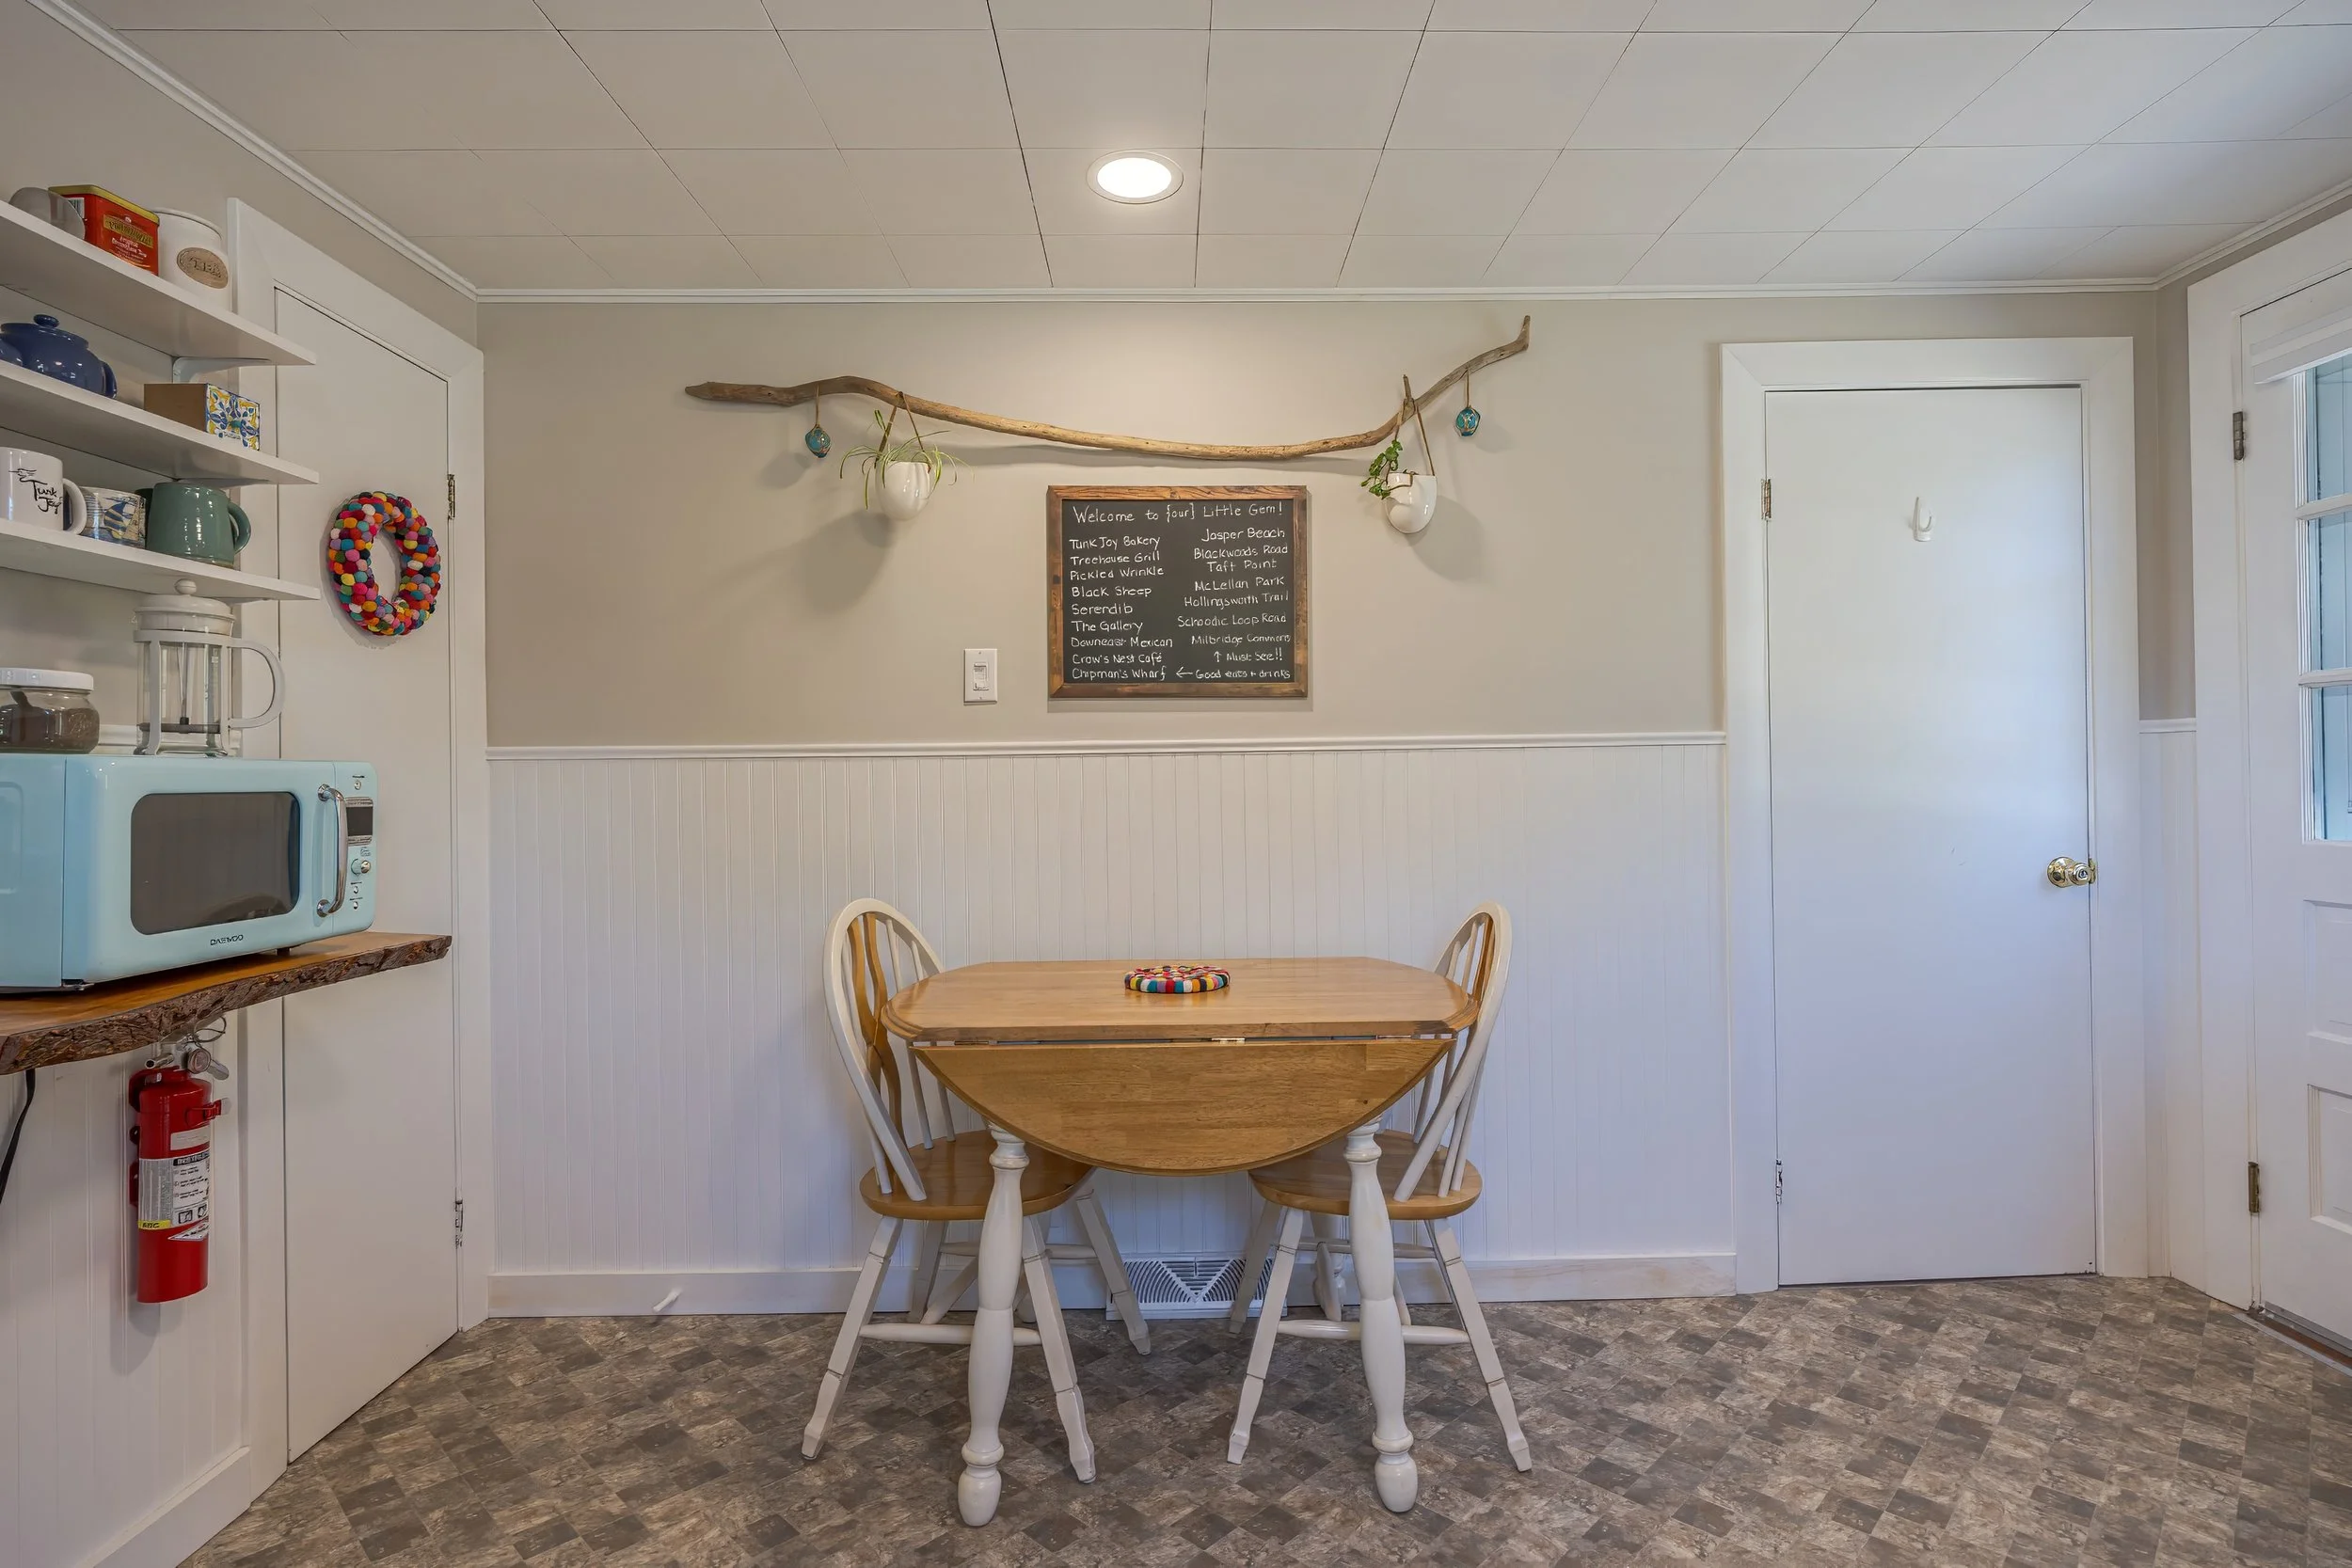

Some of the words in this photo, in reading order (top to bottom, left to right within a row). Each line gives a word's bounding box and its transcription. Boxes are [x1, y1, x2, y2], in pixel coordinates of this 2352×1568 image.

[1073, 505, 1135, 523] Welcome
[1145, 509, 1159, 520] to
[1204, 503, 1242, 516] Little
[1248, 501, 1282, 515] Gem!
[1069, 538, 1097, 549] Tunk
[1099, 537, 1118, 550] Joy
[1123, 536, 1160, 550] Bakery
[1201, 529, 1244, 544] Jasper
[1248, 528, 1285, 538] Beach
[1070, 555, 1130, 565] Treehouse
[1135, 550, 1160, 562] Grill
[1194, 546, 1258, 560] Blackwoods
[1263, 544, 1288, 554] Road
[1207, 561, 1236, 572] Taft
[1244, 559, 1277, 569] Point
[1070, 570, 1114, 580] Pickled
[1120, 566, 1164, 577] Wrinkle
[1256, 576, 1284, 586] Park
[1072, 586, 1109, 596] Black
[1115, 586, 1152, 597] Sheep
[1184, 595, 1258, 610] Hollingsworth
[1262, 591, 1288, 602] Trail
[1072, 603, 1133, 614] Serendib
[1178, 615, 1229, 626] Schoodic
[1232, 614, 1259, 627] Loop
[1262, 611, 1286, 623] Road
[1071, 621, 1096, 631] The
[1100, 620, 1143, 635] Gallery
[1071, 637, 1126, 647] Downeast
[1130, 636, 1173, 647] Mexican
[1073, 654, 1109, 664] Crow's
[1113, 655, 1135, 663] Nest
[1227, 652, 1251, 661] Must
[1073, 668, 1128, 680] Chipman's
[1132, 665, 1167, 681] Wharf
[1196, 670, 1221, 678] Good
[1260, 670, 1291, 678] drinks
